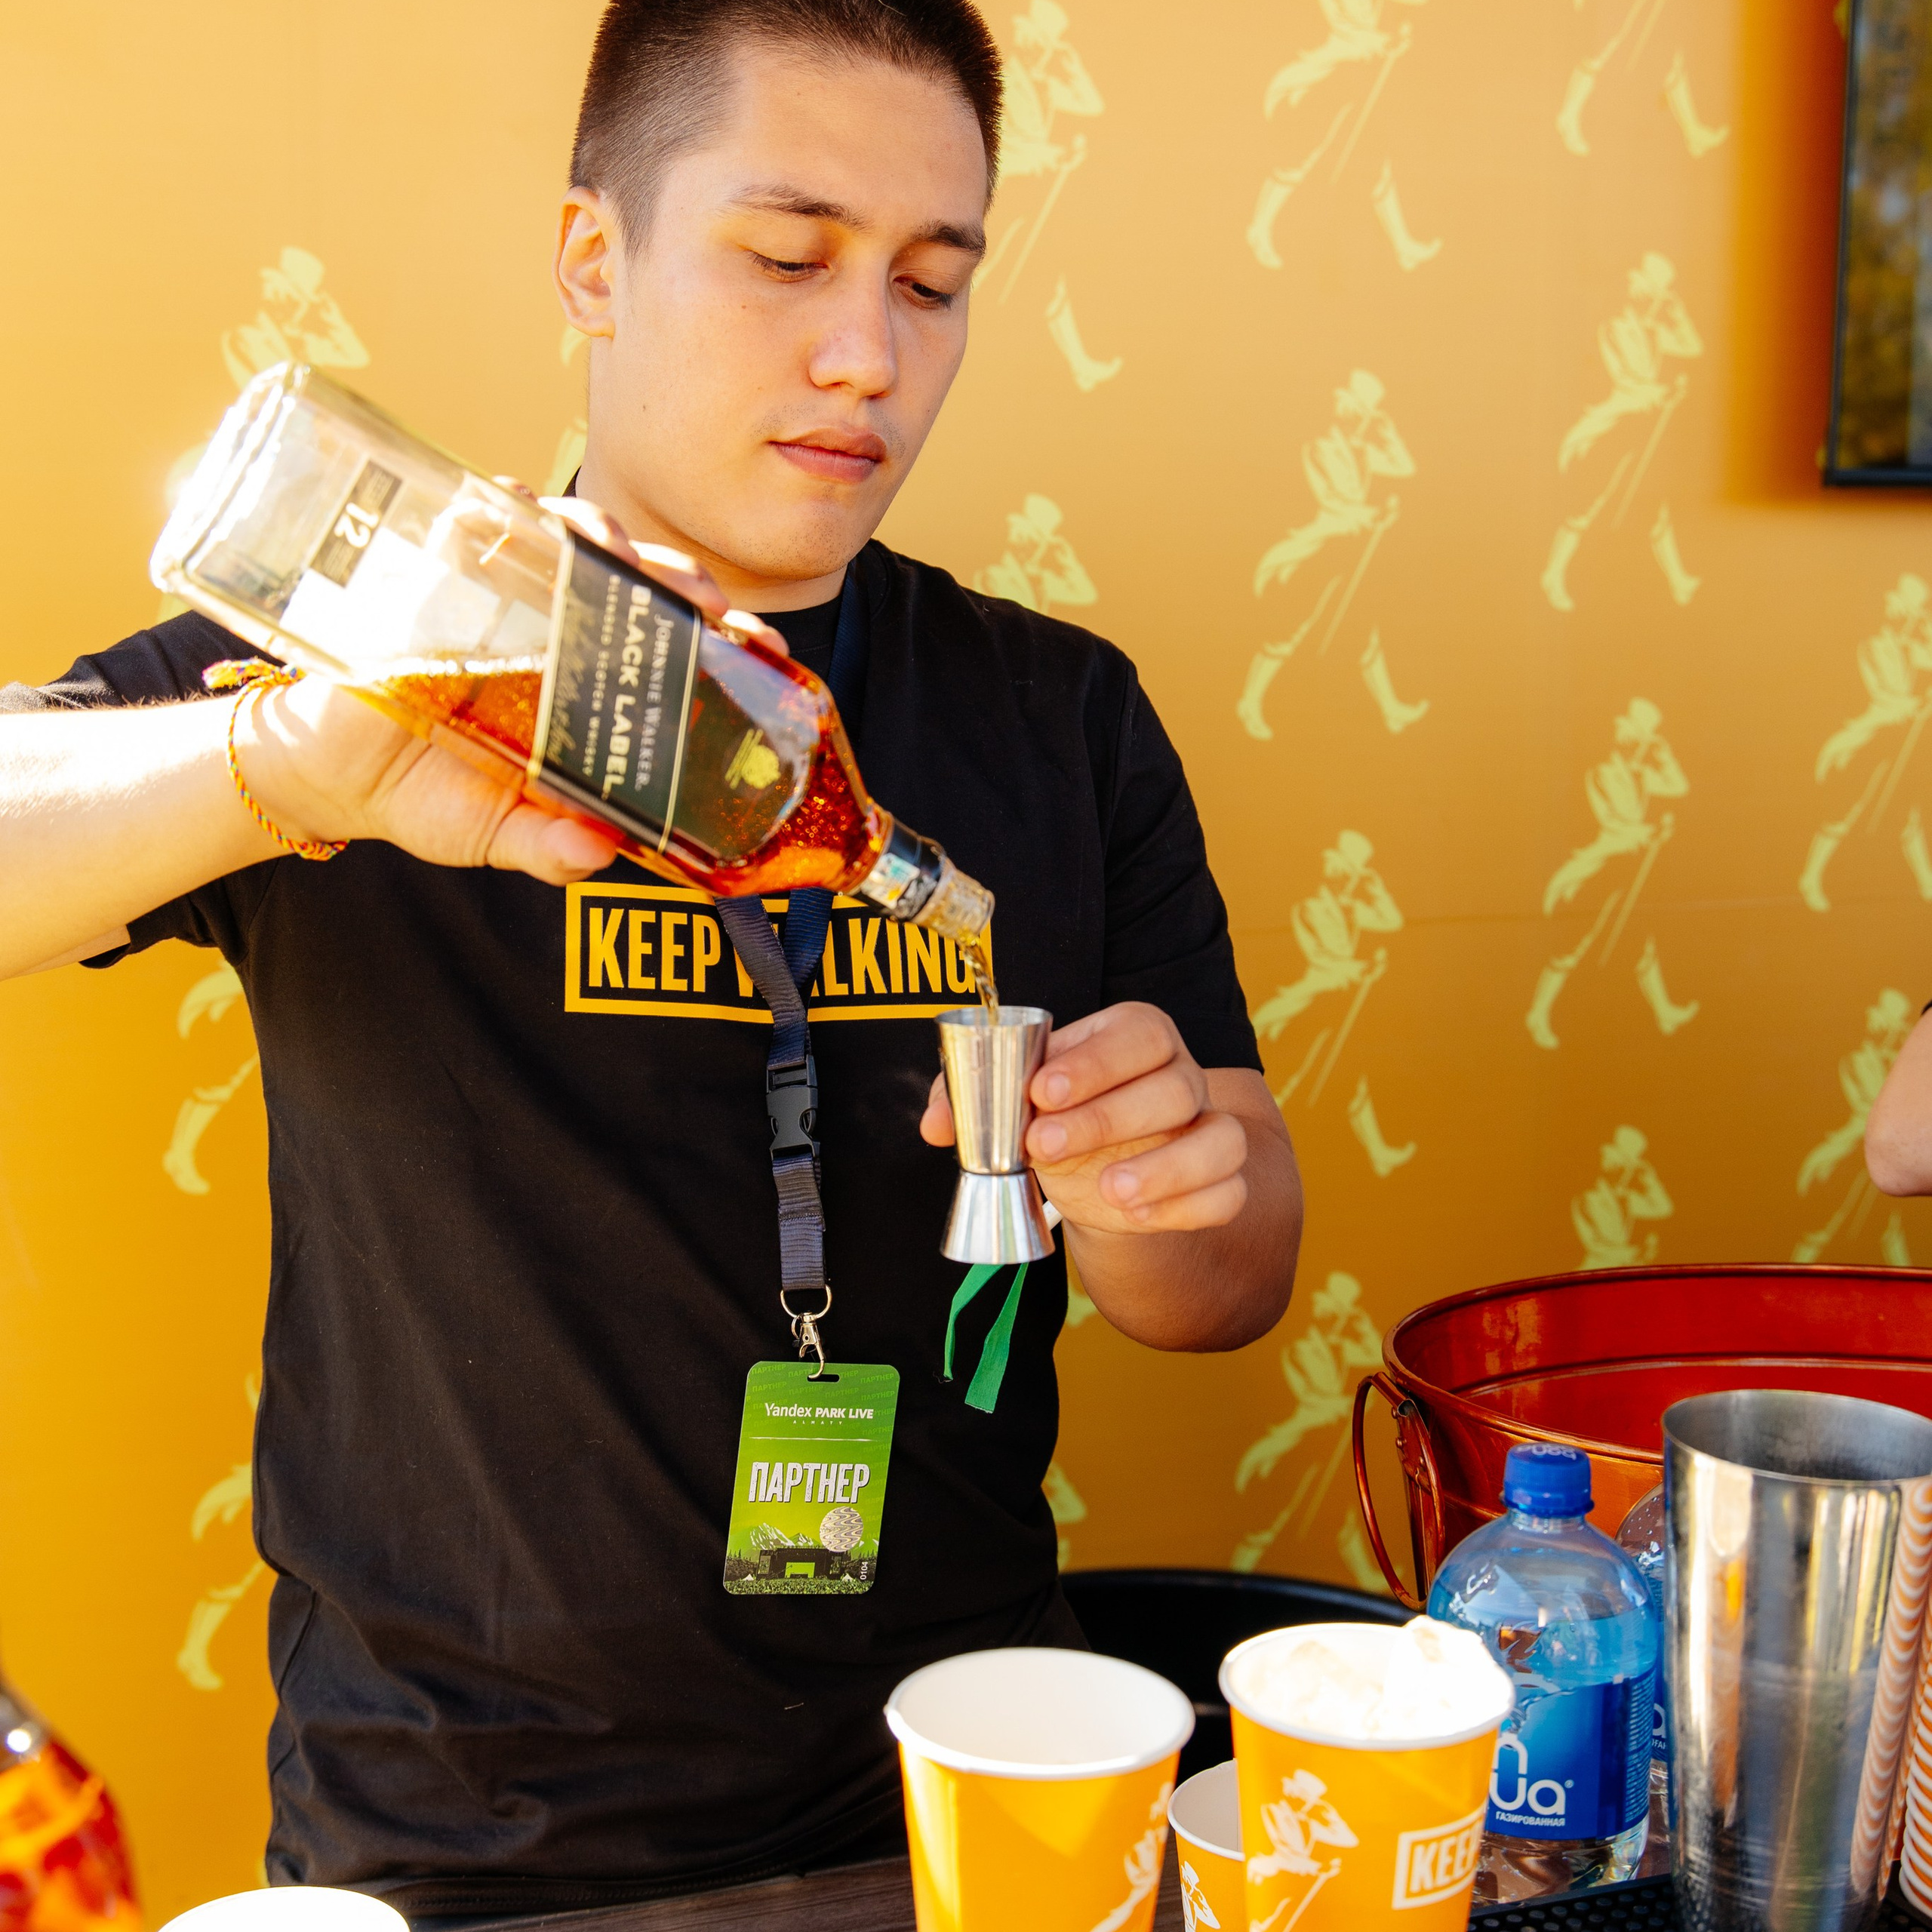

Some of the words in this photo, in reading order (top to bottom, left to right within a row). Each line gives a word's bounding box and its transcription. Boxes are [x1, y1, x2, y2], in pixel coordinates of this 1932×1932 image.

[334, 503, 380, 549] 12
[618, 584, 651, 688] BLACK
[647, 614, 674, 703] JOHNNIE
[601, 694, 636, 800] LABEL
[589, 907, 721, 993] KEEP
[733, 916, 977, 998] LKING
[764, 1402, 812, 1417] Yandex
[815, 1407, 846, 1418] PARK
[848, 1408, 875, 1419] LIVE
[748, 1462, 871, 1503] ПАРТНЕР
[860, 1561, 869, 1580] 0104
[1495, 1811, 1566, 1827] ГАЗИРОВАННАЯ
